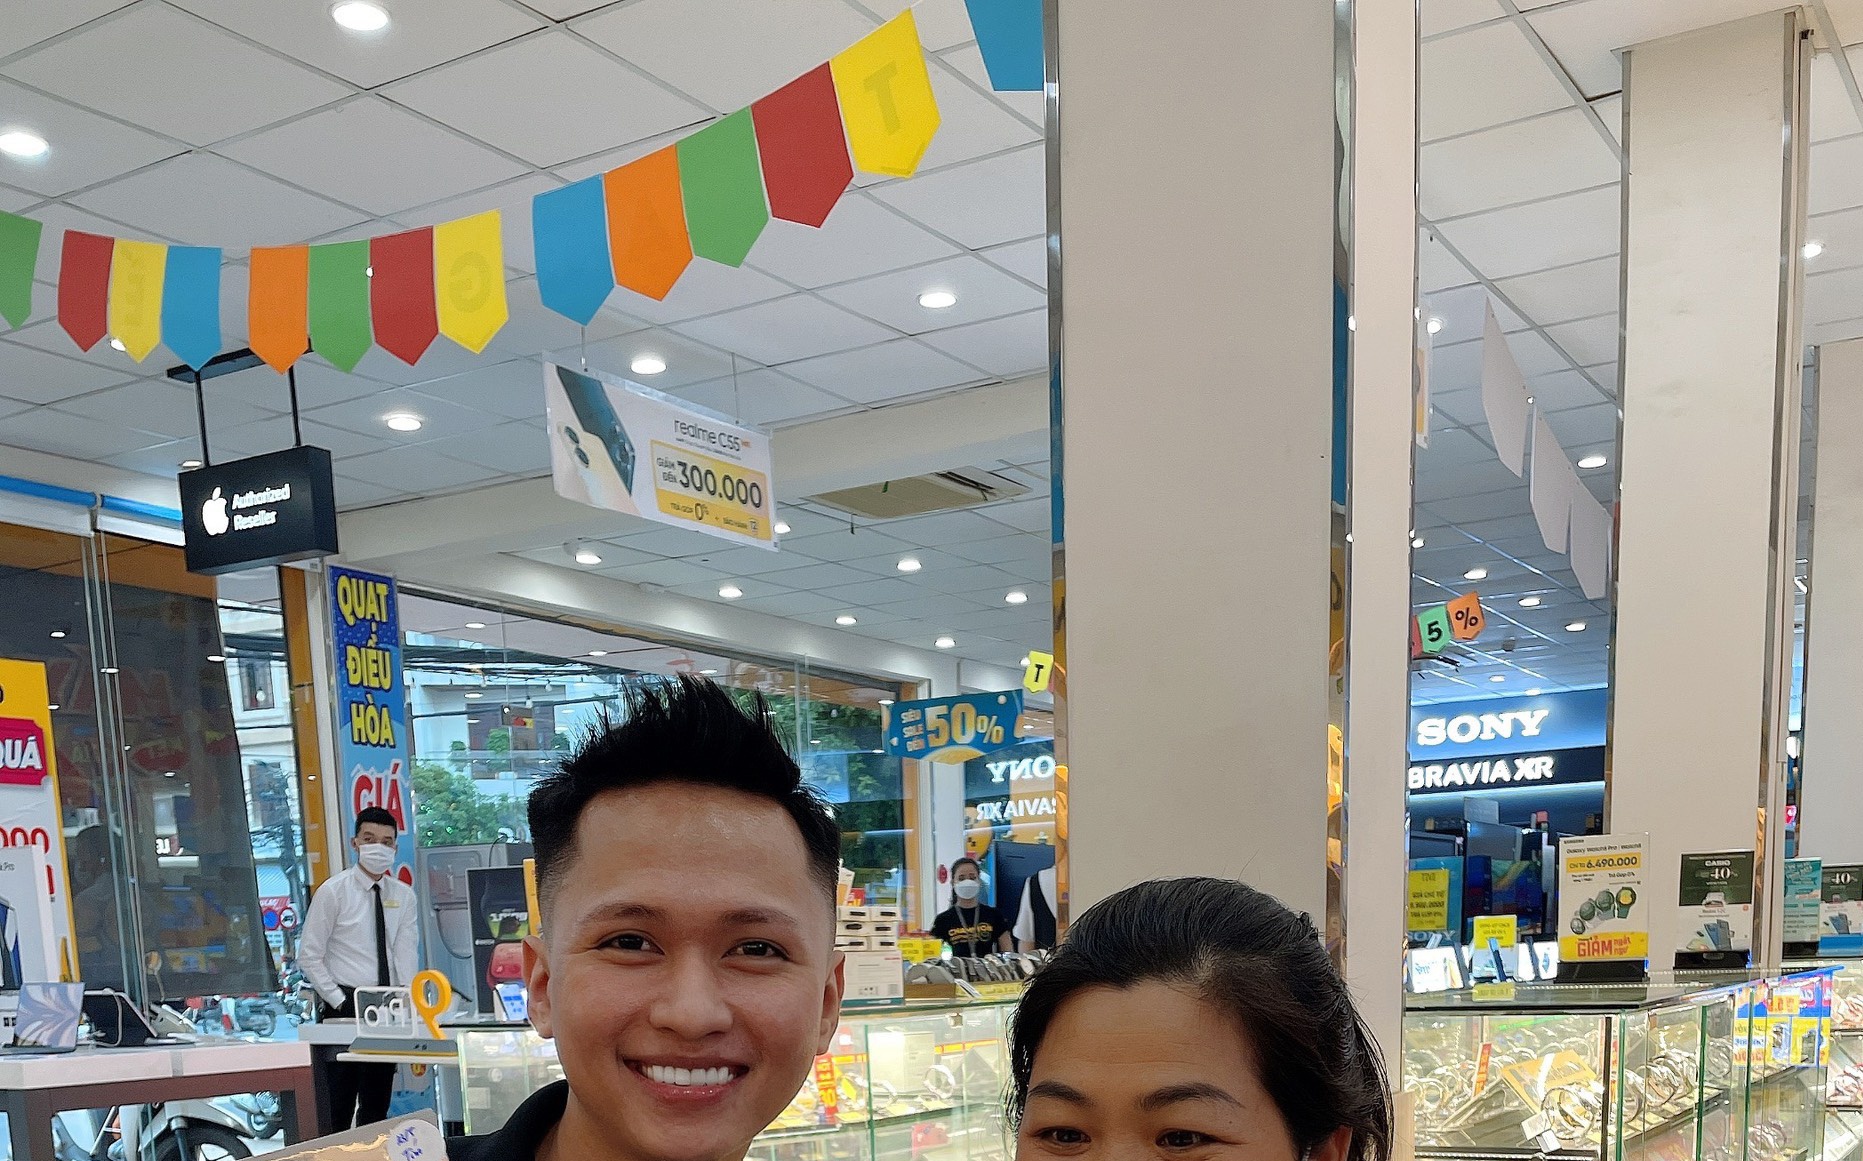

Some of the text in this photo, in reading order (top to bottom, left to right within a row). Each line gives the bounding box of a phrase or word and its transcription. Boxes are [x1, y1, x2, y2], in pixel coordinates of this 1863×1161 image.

[673, 419, 717, 445] realme
[718, 432, 741, 452] C55
[231, 483, 292, 510] Authorized
[677, 460, 762, 508] 300.000
[233, 509, 278, 532] Reseller
[350, 694, 395, 747] HÒA
[925, 702, 1004, 748] 50%
[1417, 709, 1550, 746] SONY
[1408, 755, 1554, 789] BRAVIA XR
[1586, 856, 1638, 869] 6.490.000
[1577, 935, 1613, 957] GIẢM
